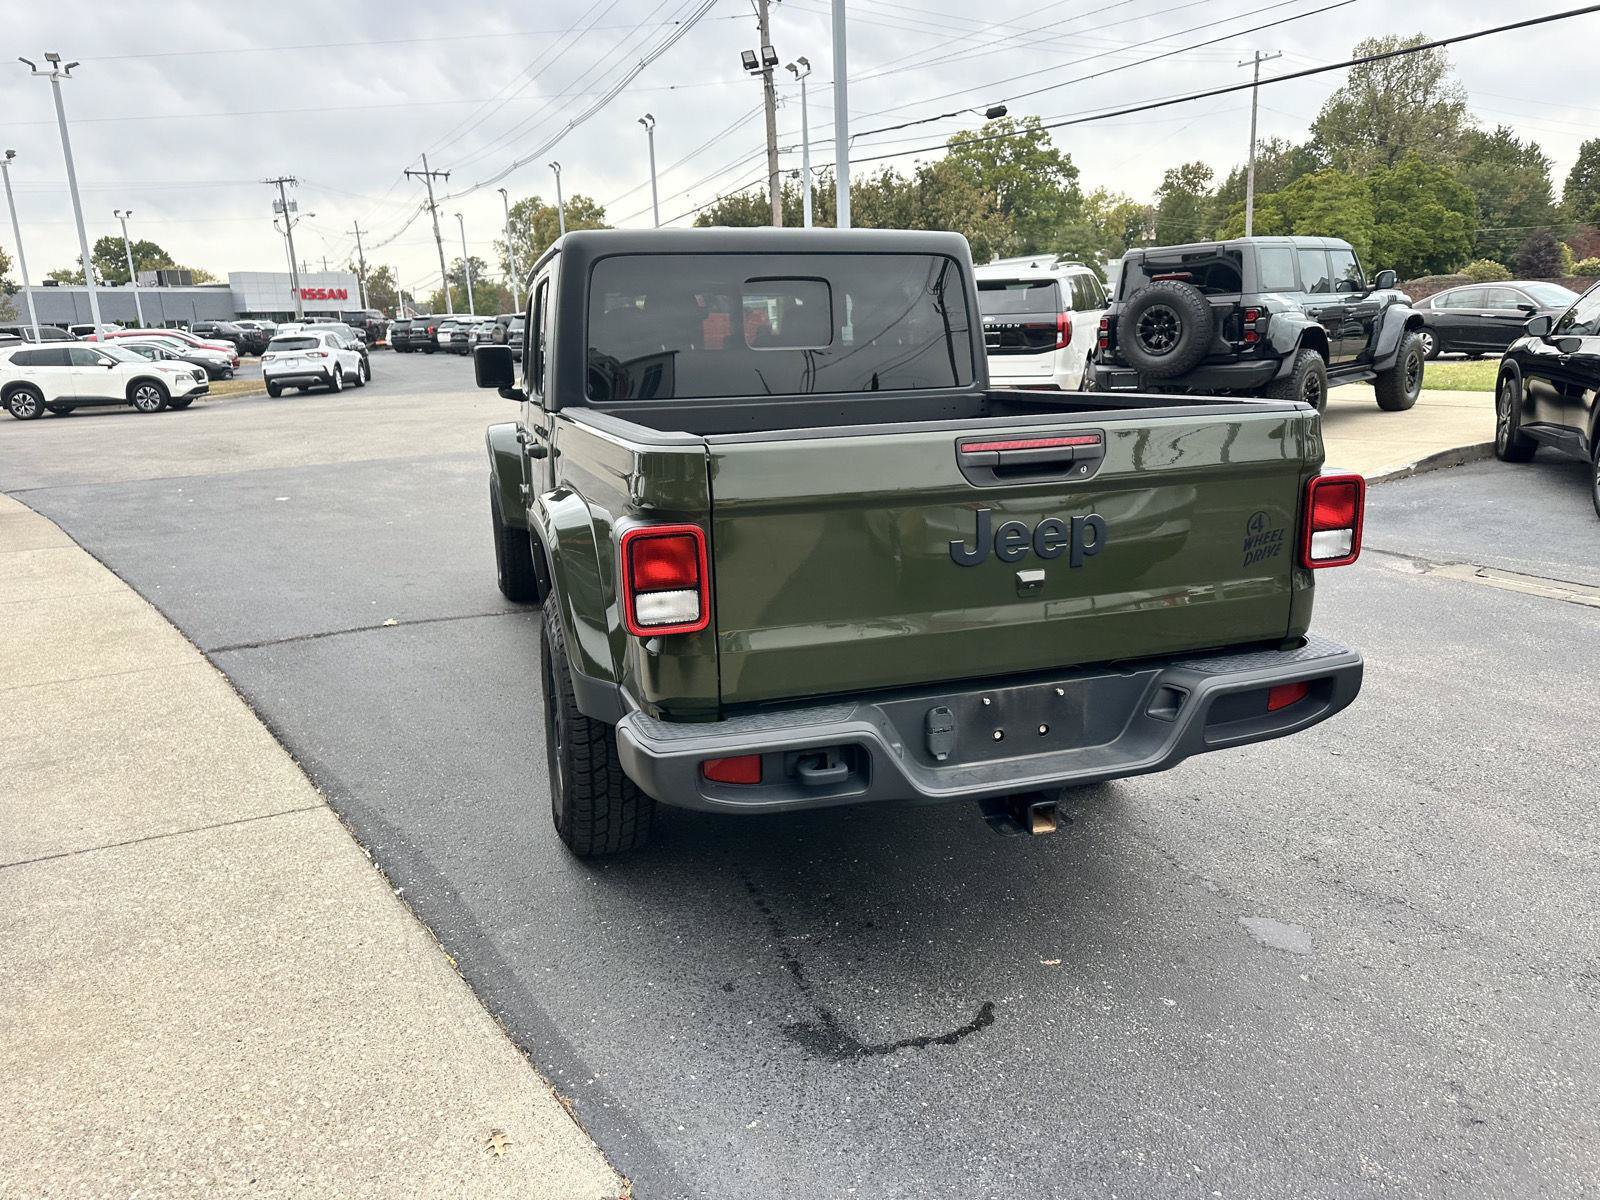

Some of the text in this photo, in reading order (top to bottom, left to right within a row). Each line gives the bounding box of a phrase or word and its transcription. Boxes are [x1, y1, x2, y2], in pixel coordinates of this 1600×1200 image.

[1251, 514, 1264, 532] 4
[949, 508, 1106, 568] Jeep
[1243, 528, 1284, 552] WHEEL
[1242, 543, 1282, 568] DRIVE
